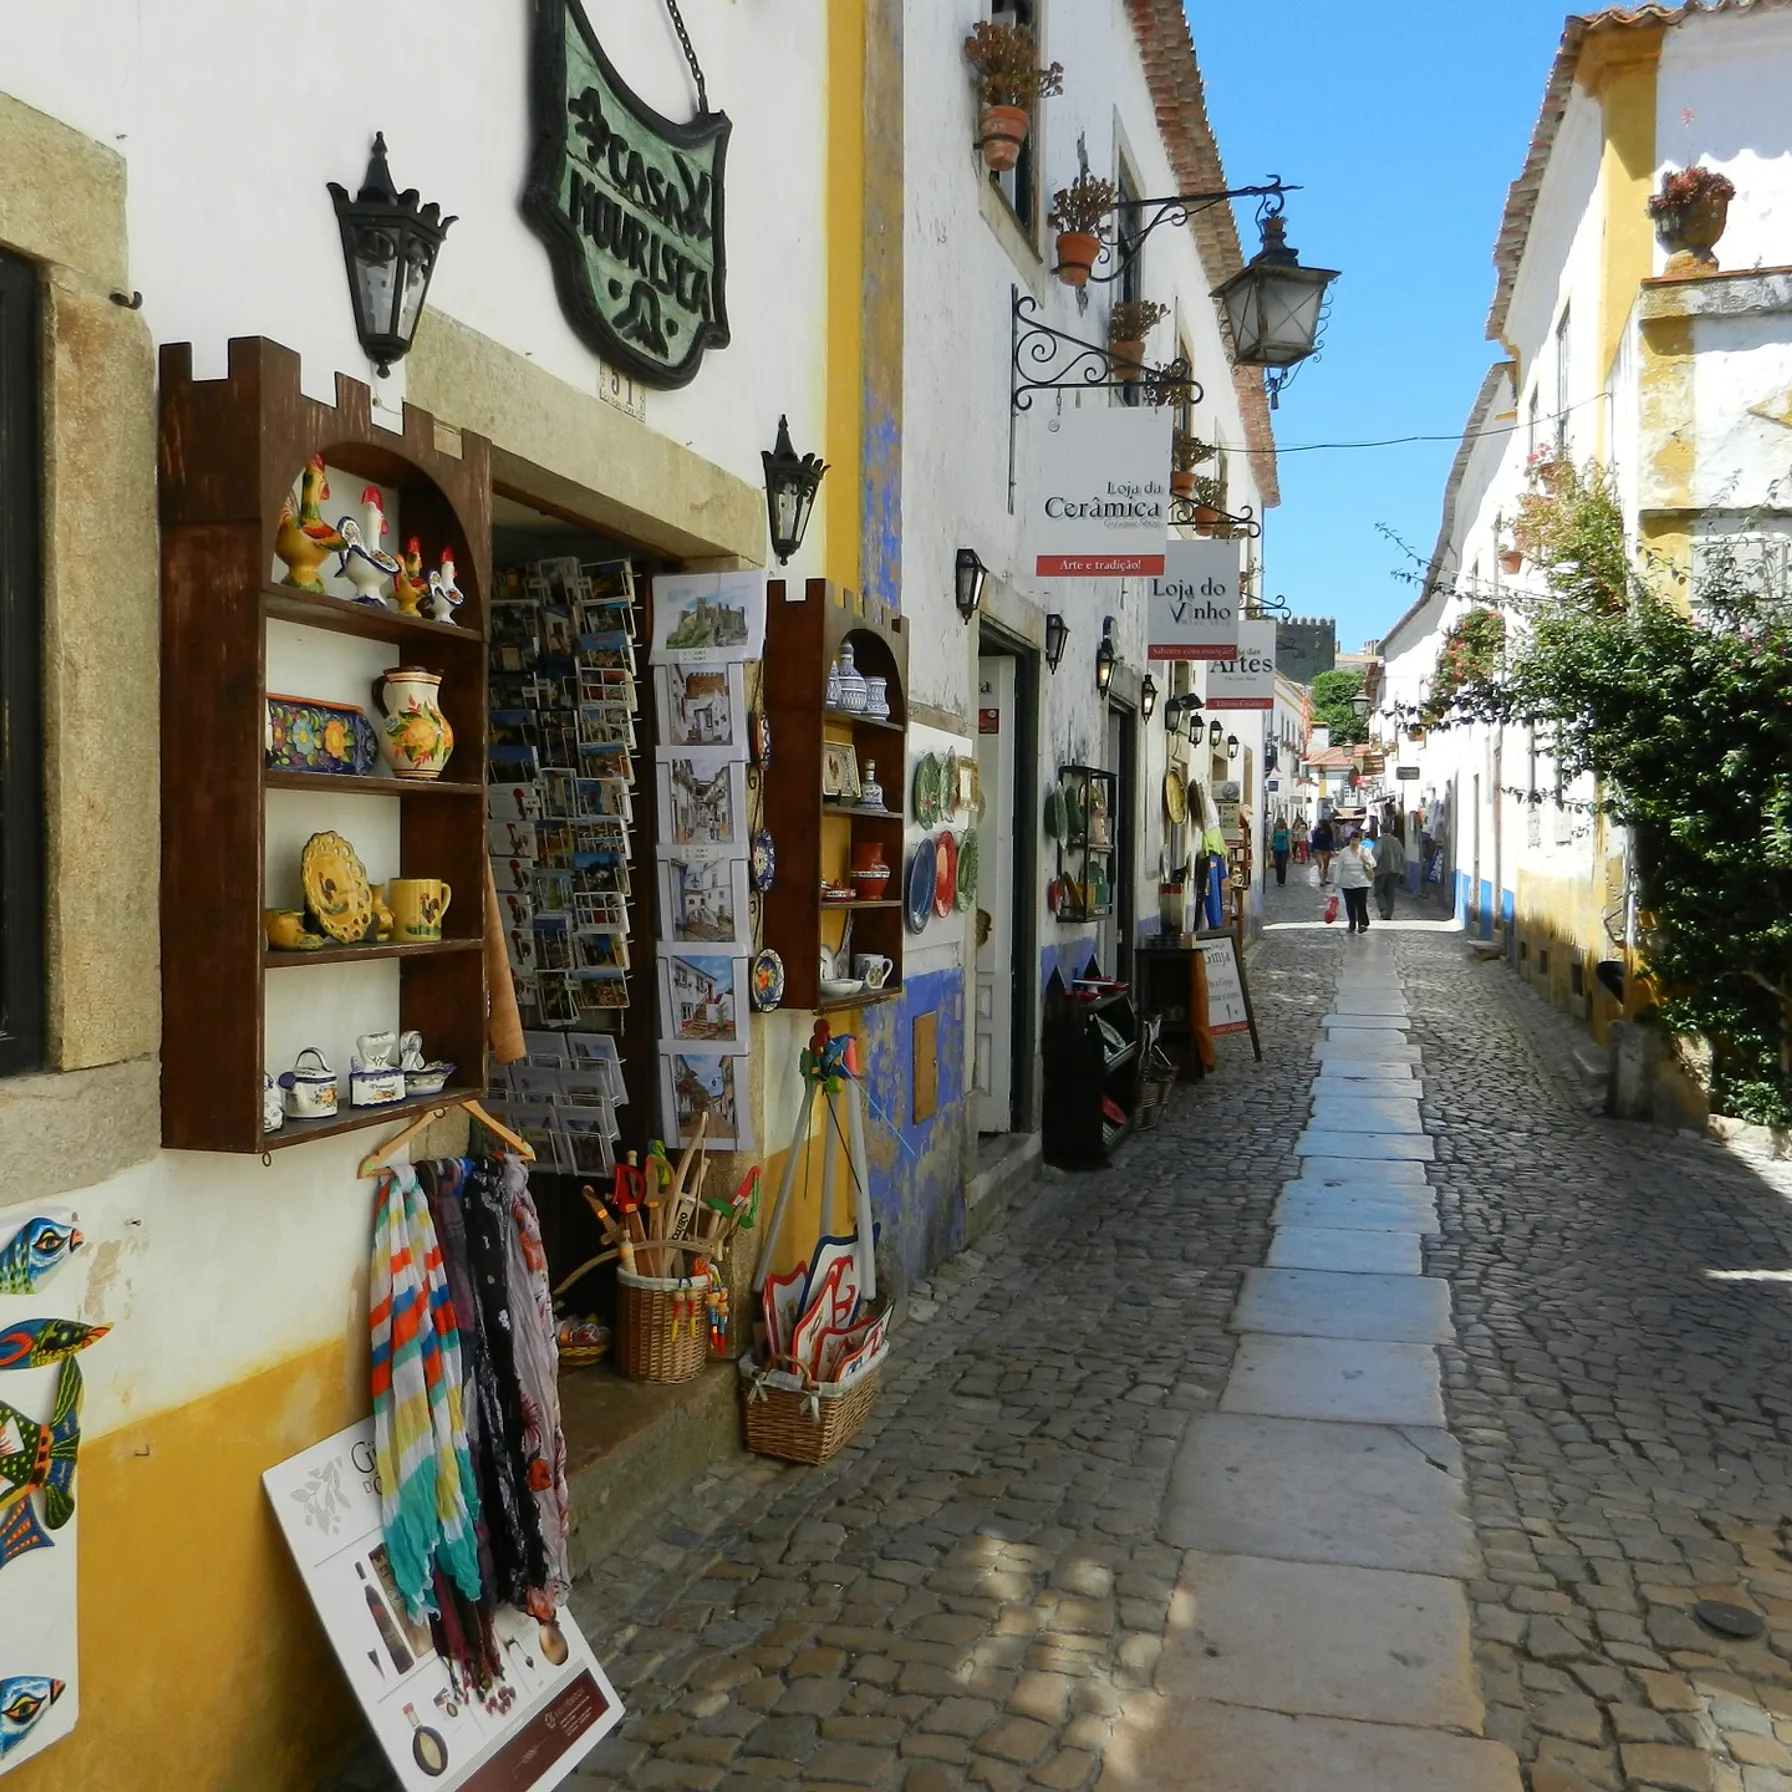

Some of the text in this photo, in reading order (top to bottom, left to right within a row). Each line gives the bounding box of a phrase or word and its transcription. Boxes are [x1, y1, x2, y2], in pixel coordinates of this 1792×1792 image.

[608, 132, 688, 236] CASA
[1107, 481, 1161, 497] Loja da
[1044, 496, 1160, 519] Cerâmica
[1060, 560, 1083, 570] Arte
[1095, 560, 1141, 571] tradição!
[1152, 577, 1226, 600] Loja do
[1209, 656, 1273, 673] Artes
